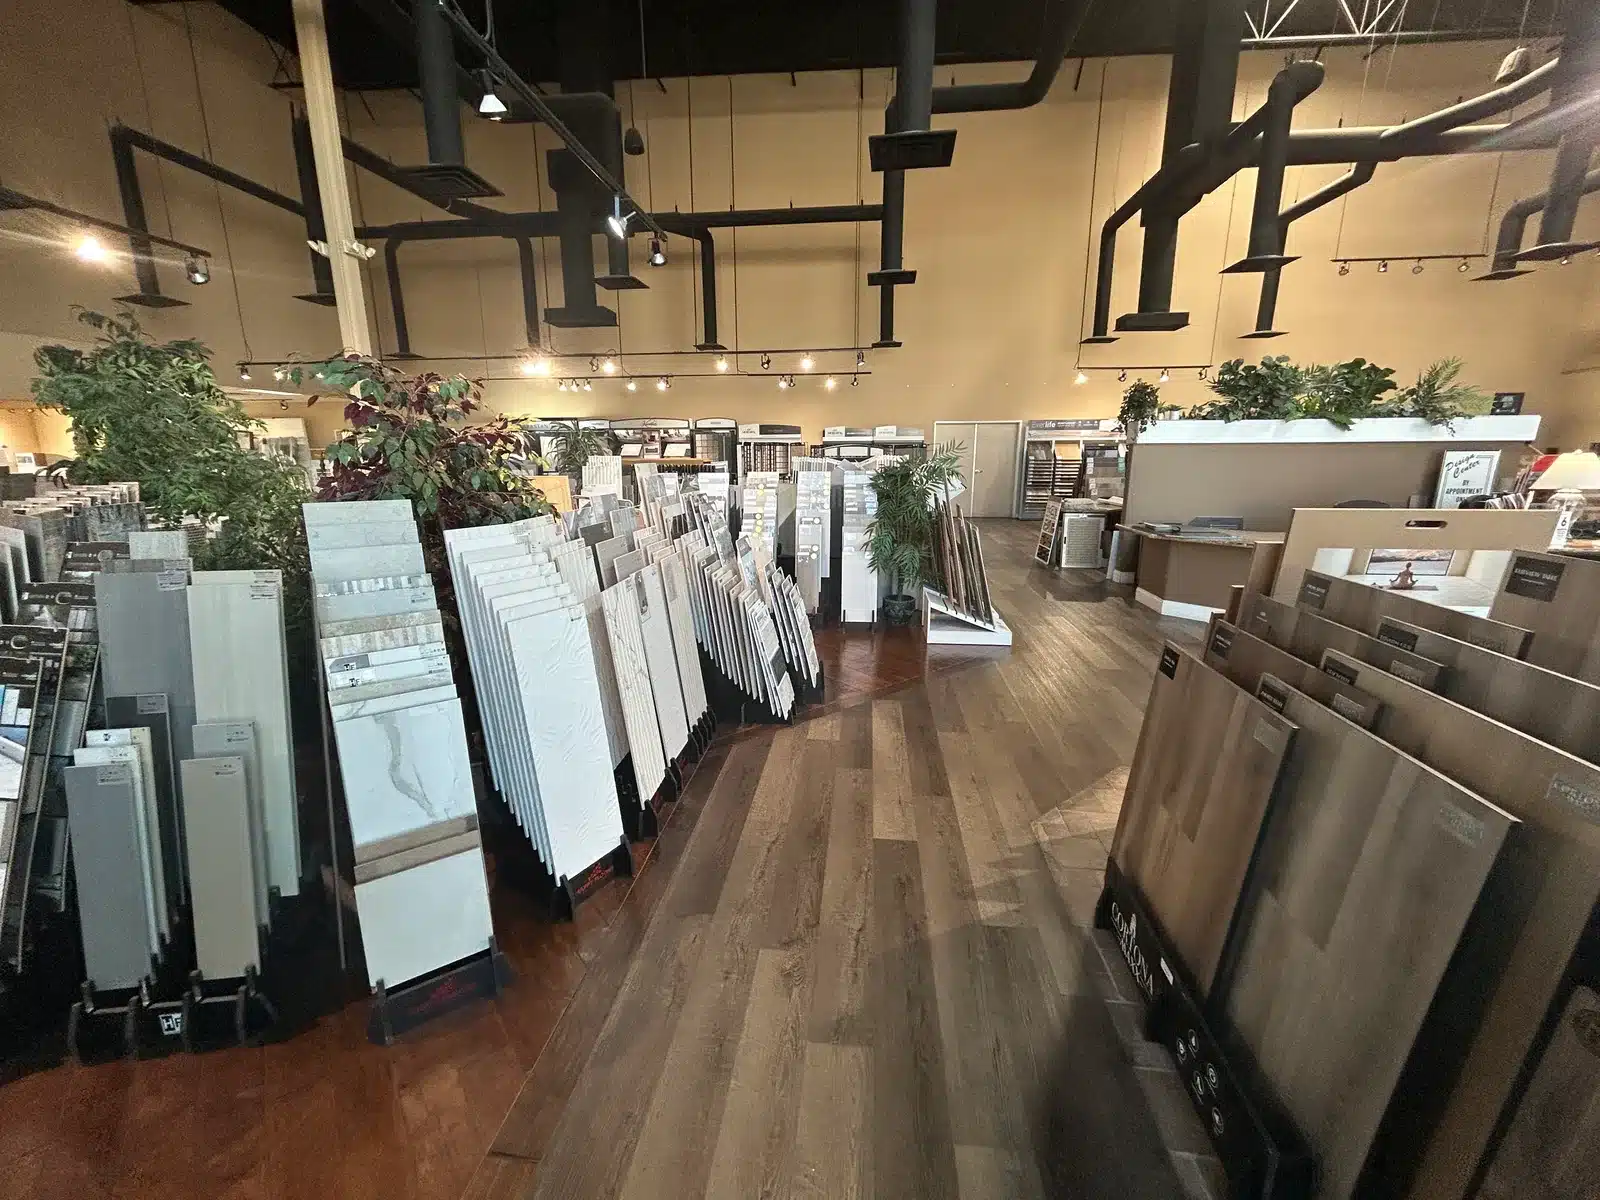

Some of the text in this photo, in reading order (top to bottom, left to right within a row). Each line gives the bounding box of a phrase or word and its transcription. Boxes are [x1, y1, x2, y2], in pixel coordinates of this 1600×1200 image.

[1445, 454, 1475, 471] Design
[1453, 460, 1480, 478] Center
[1111, 902, 1153, 995] CORTONA
